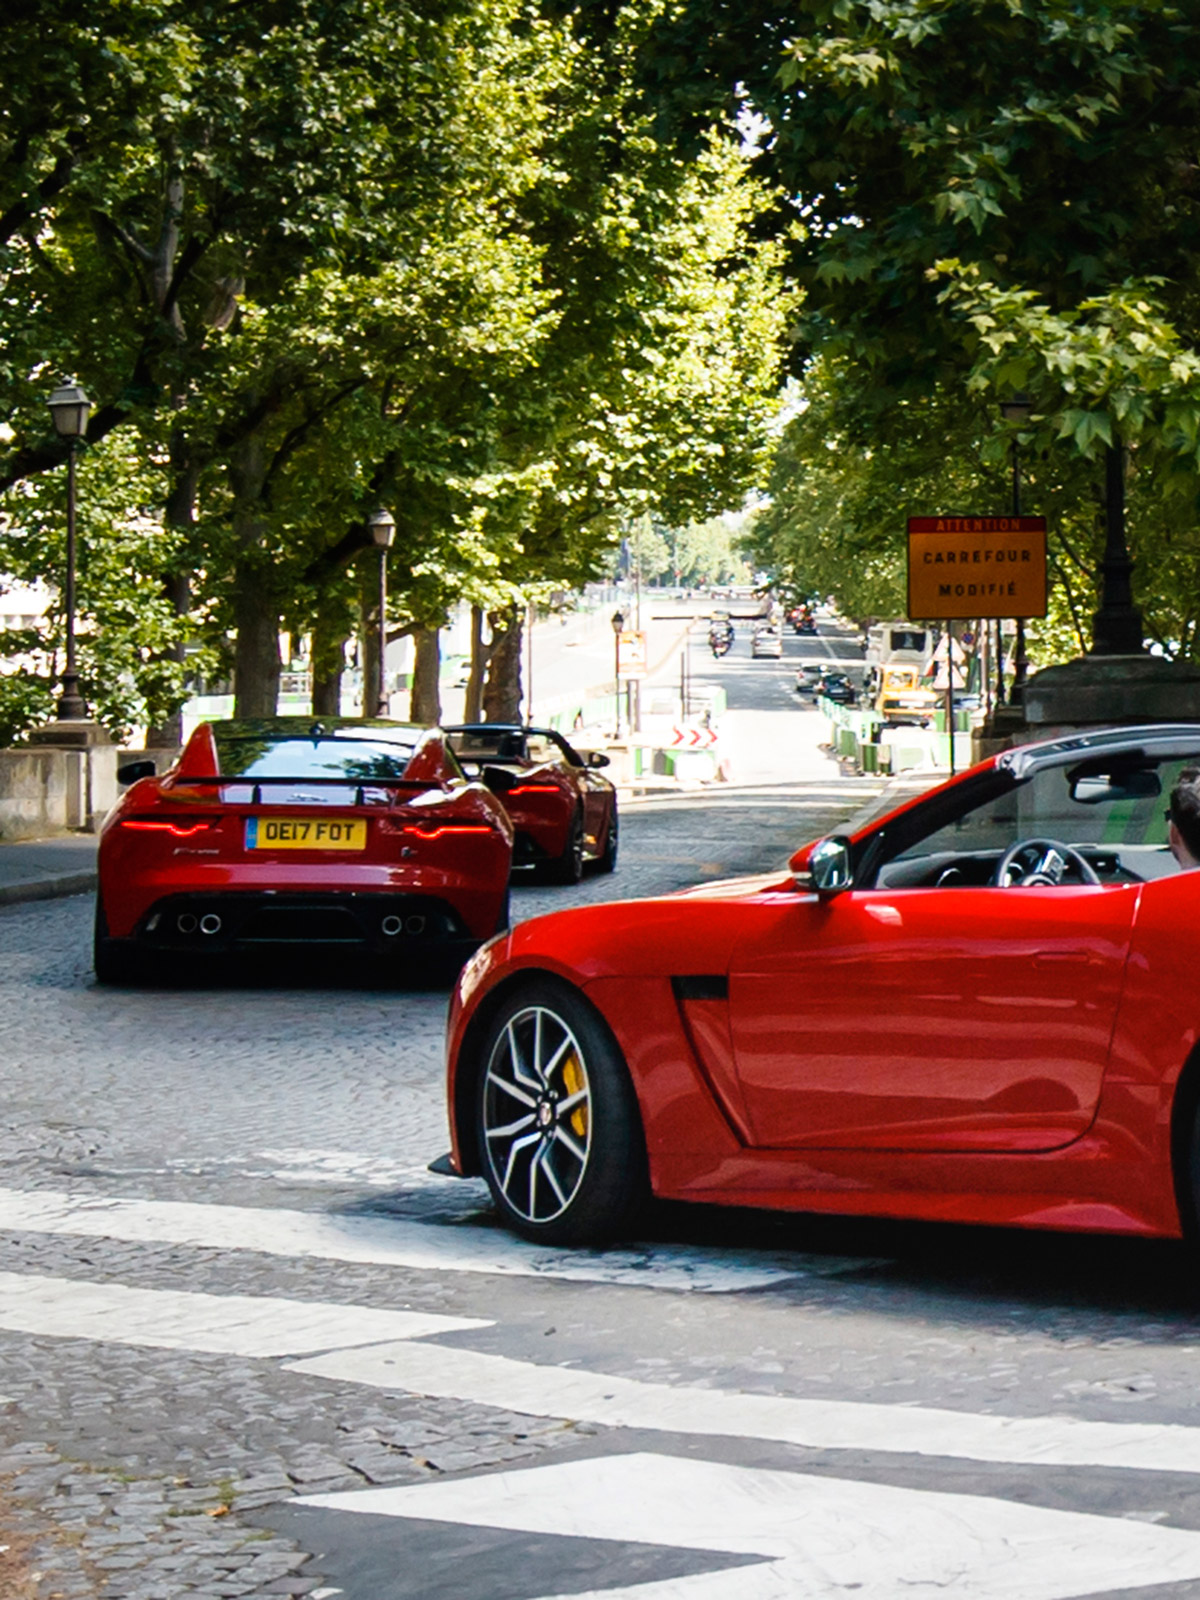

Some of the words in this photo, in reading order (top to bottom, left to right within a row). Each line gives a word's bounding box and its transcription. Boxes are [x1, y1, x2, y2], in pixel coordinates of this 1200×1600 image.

[936, 518, 1020, 532] ATTENTION
[923, 549, 1032, 564] CARREFOUR
[938, 580, 1018, 597] MODIFIÉ
[265, 822, 312, 841] OE17
[315, 822, 355, 841] FOT
